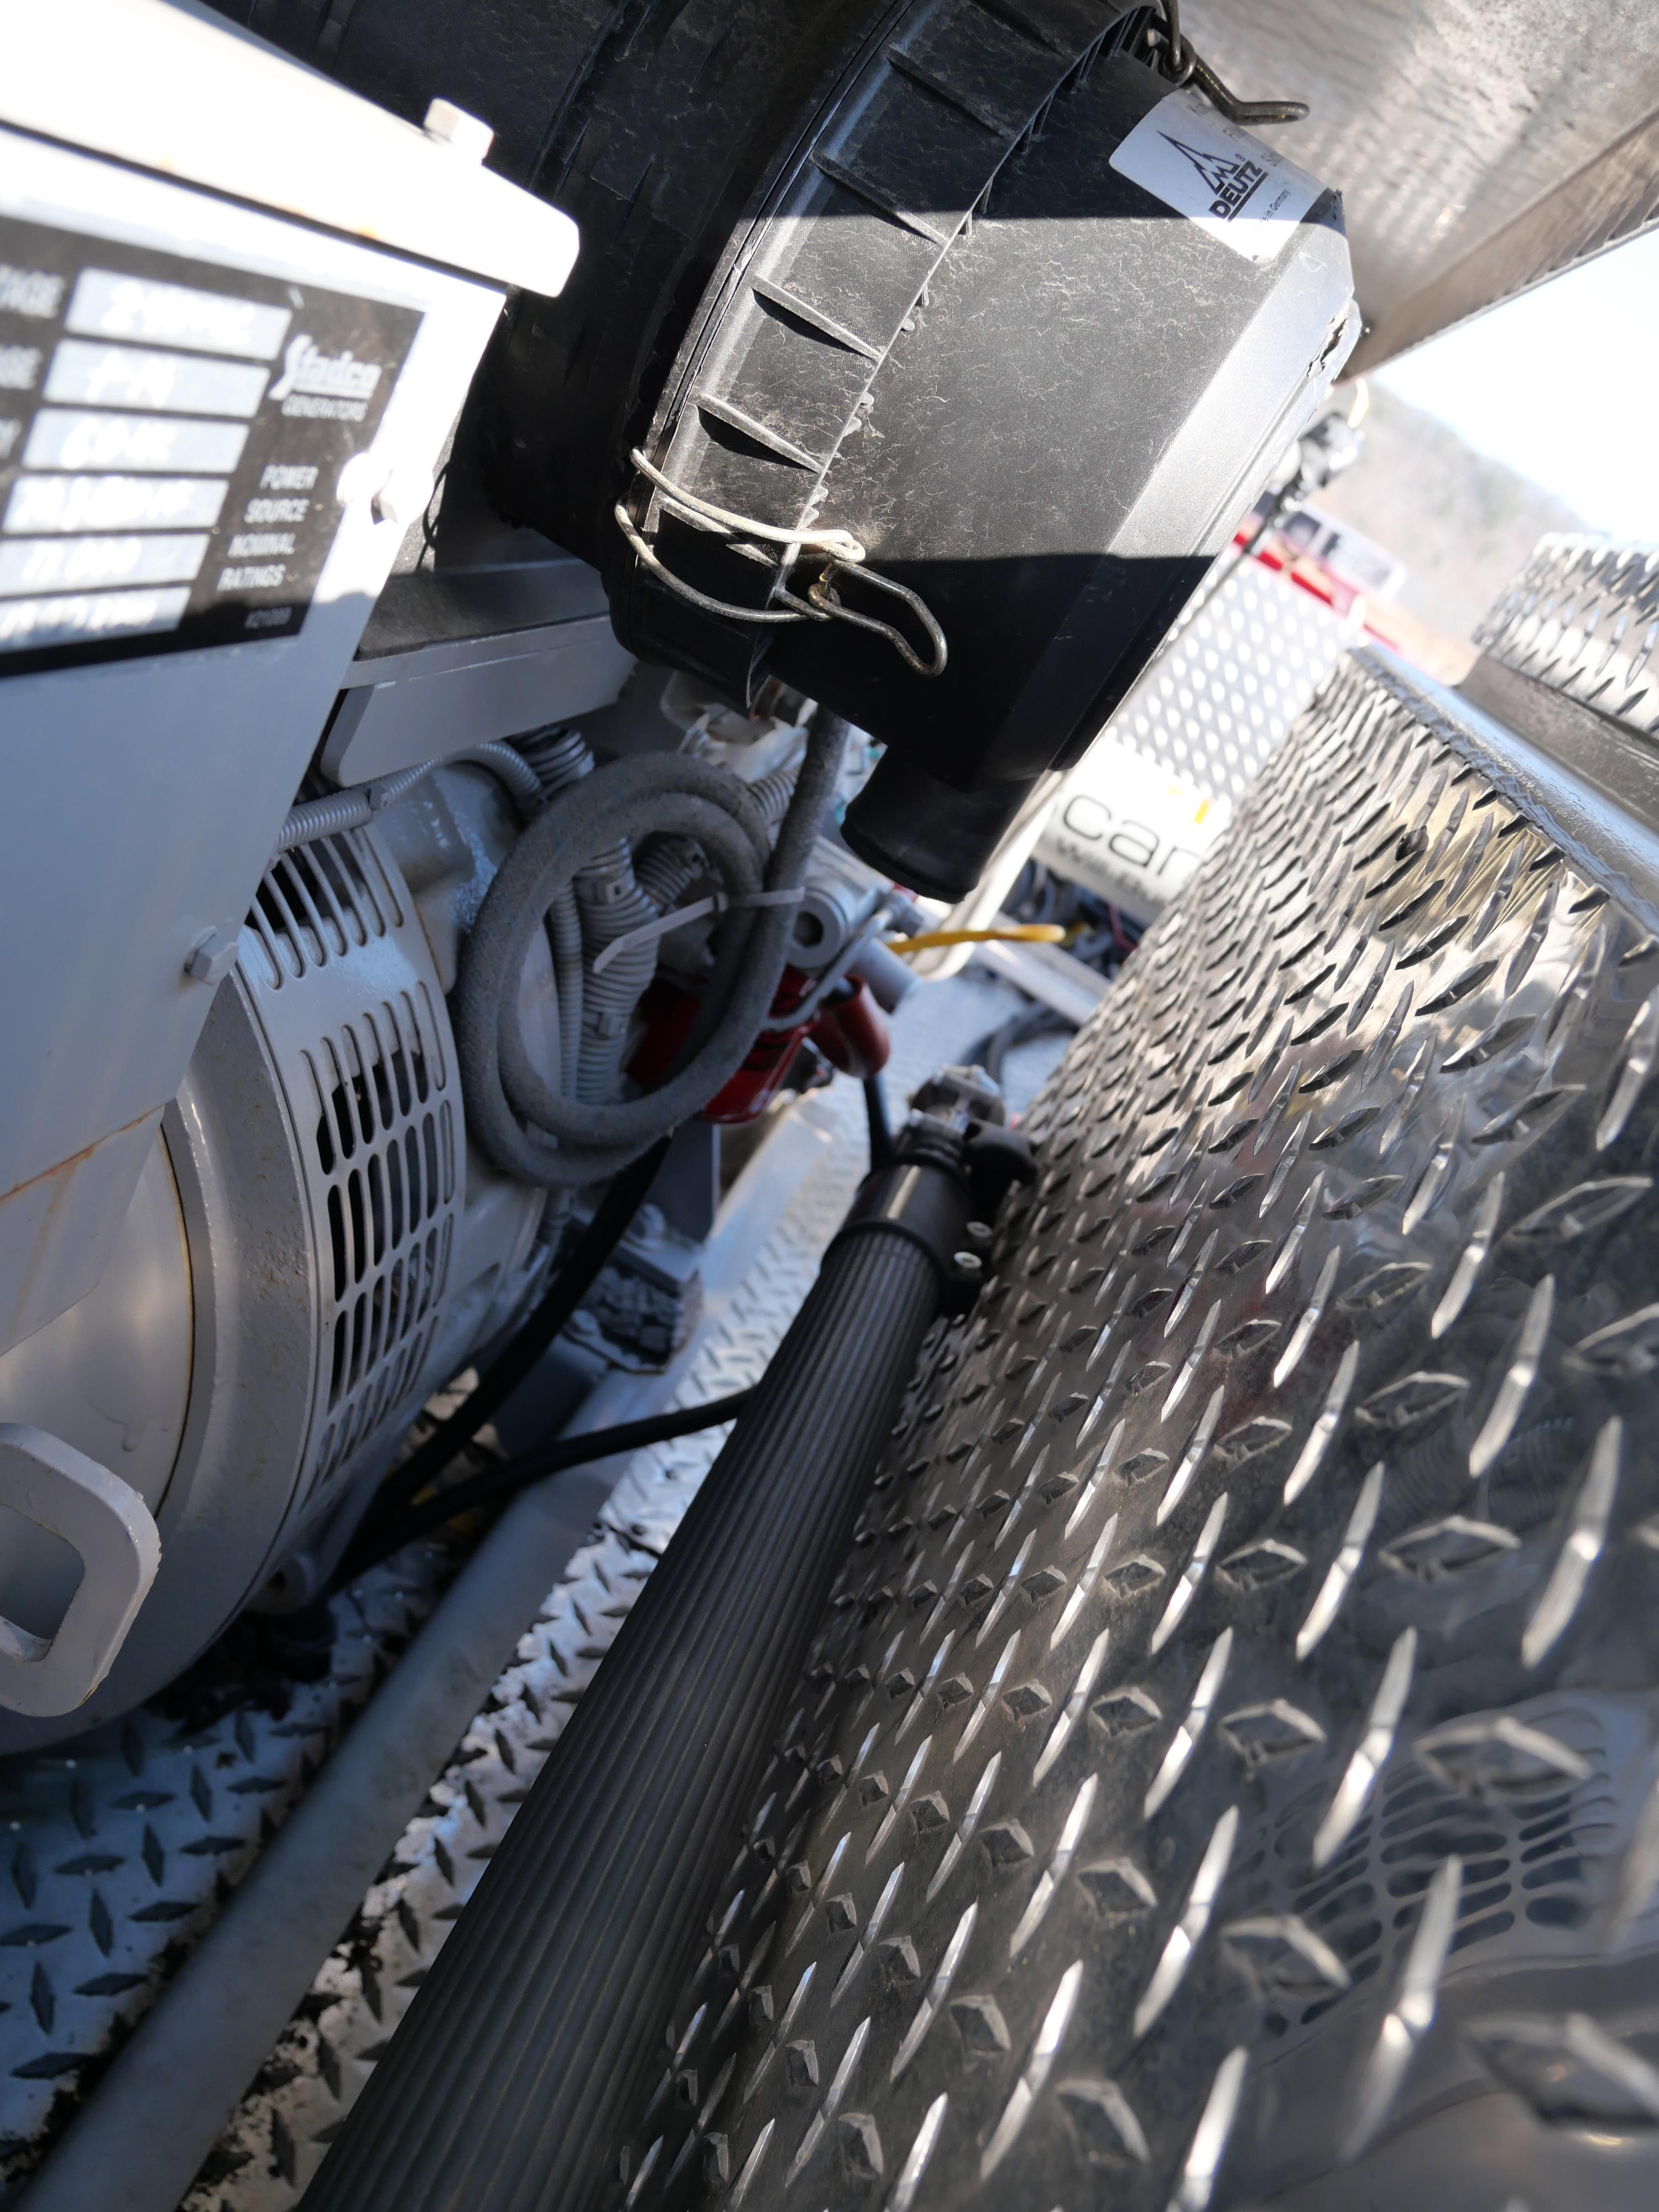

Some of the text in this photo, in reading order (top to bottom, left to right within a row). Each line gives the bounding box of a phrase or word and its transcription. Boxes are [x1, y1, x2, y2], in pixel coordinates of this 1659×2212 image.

[1208, 160, 1263, 220] DEUTZ
[1270, 189, 1291, 211] Germany
[259, 465, 319, 490] POWER
[244, 498, 310, 524] SOURCE
[228, 533, 296, 558] NOMINAL
[217, 564, 286, 592] RATINGS
